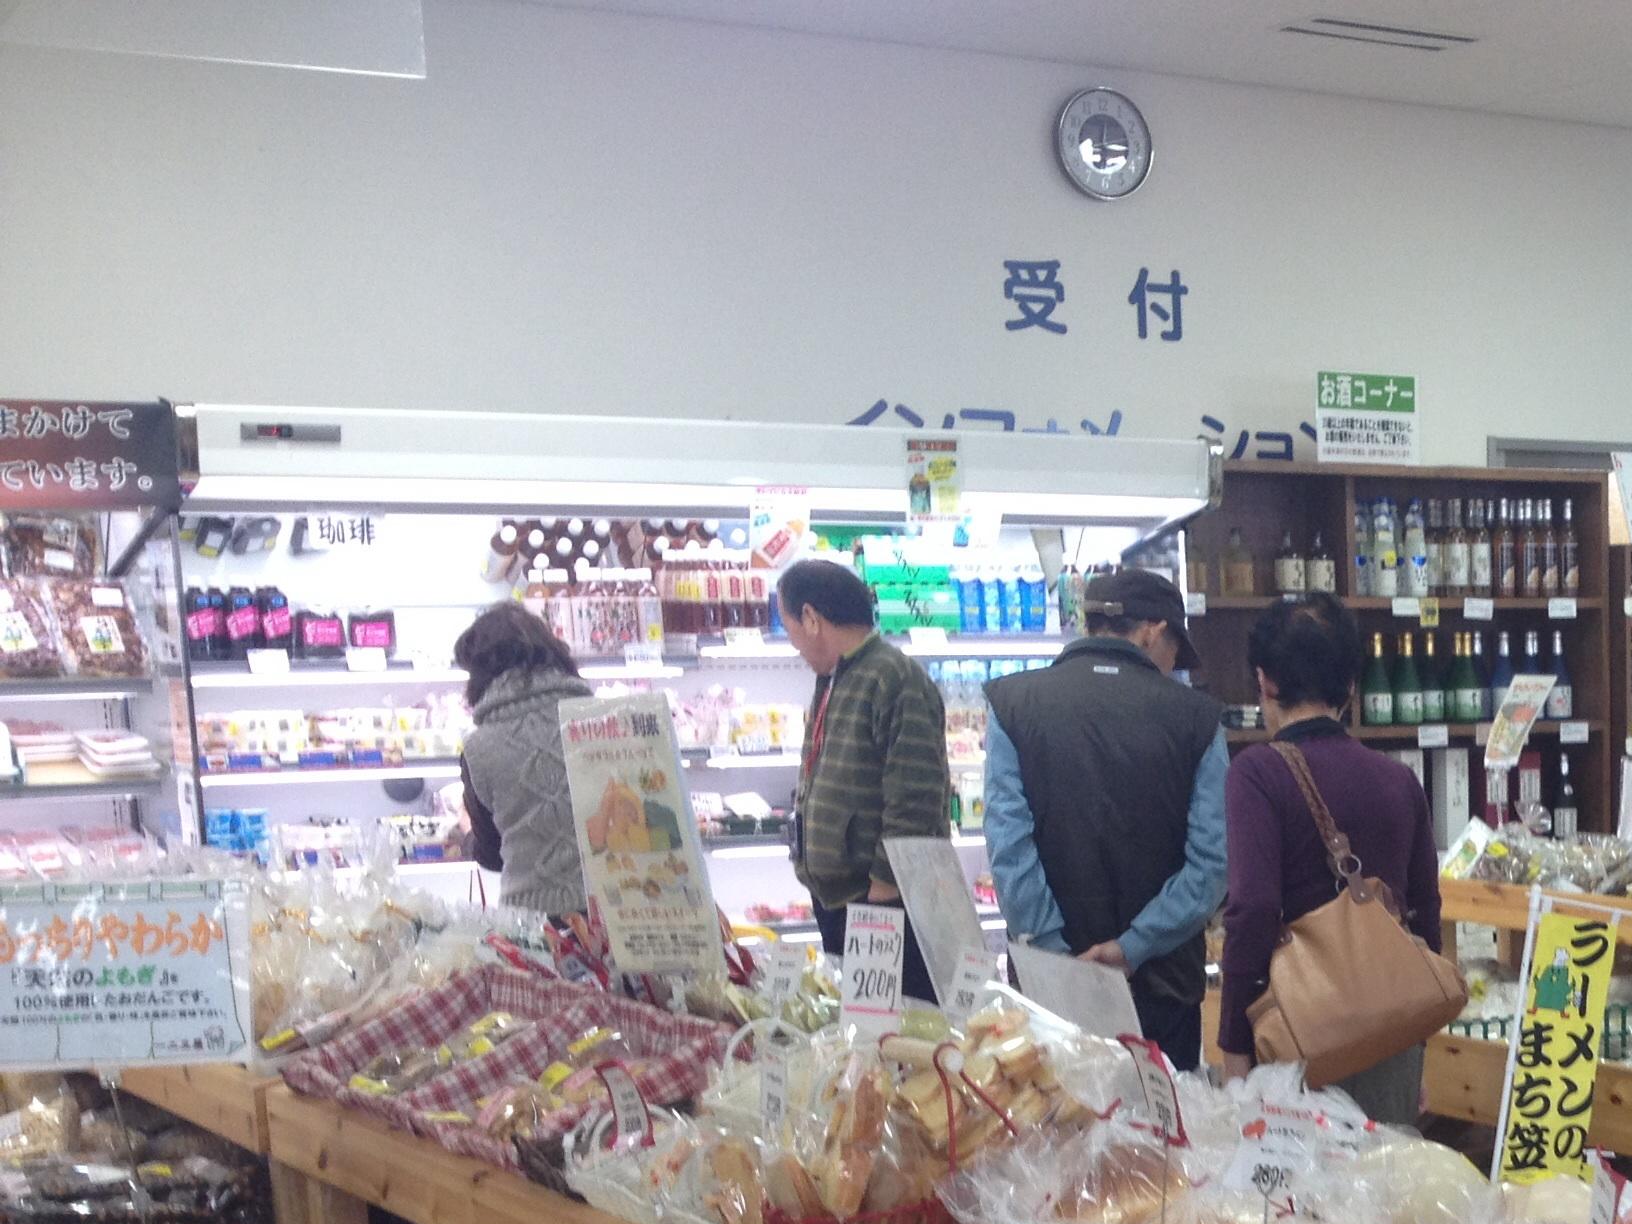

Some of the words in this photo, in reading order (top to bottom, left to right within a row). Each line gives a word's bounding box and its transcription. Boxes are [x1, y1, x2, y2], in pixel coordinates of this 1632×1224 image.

[1002, 259, 1190, 342] 受付
[1320, 374, 1414, 408] お酒コーナー
[853, 967, 897, 1013] 200円
[1553, 920, 1610, 1161] ラーメンの
